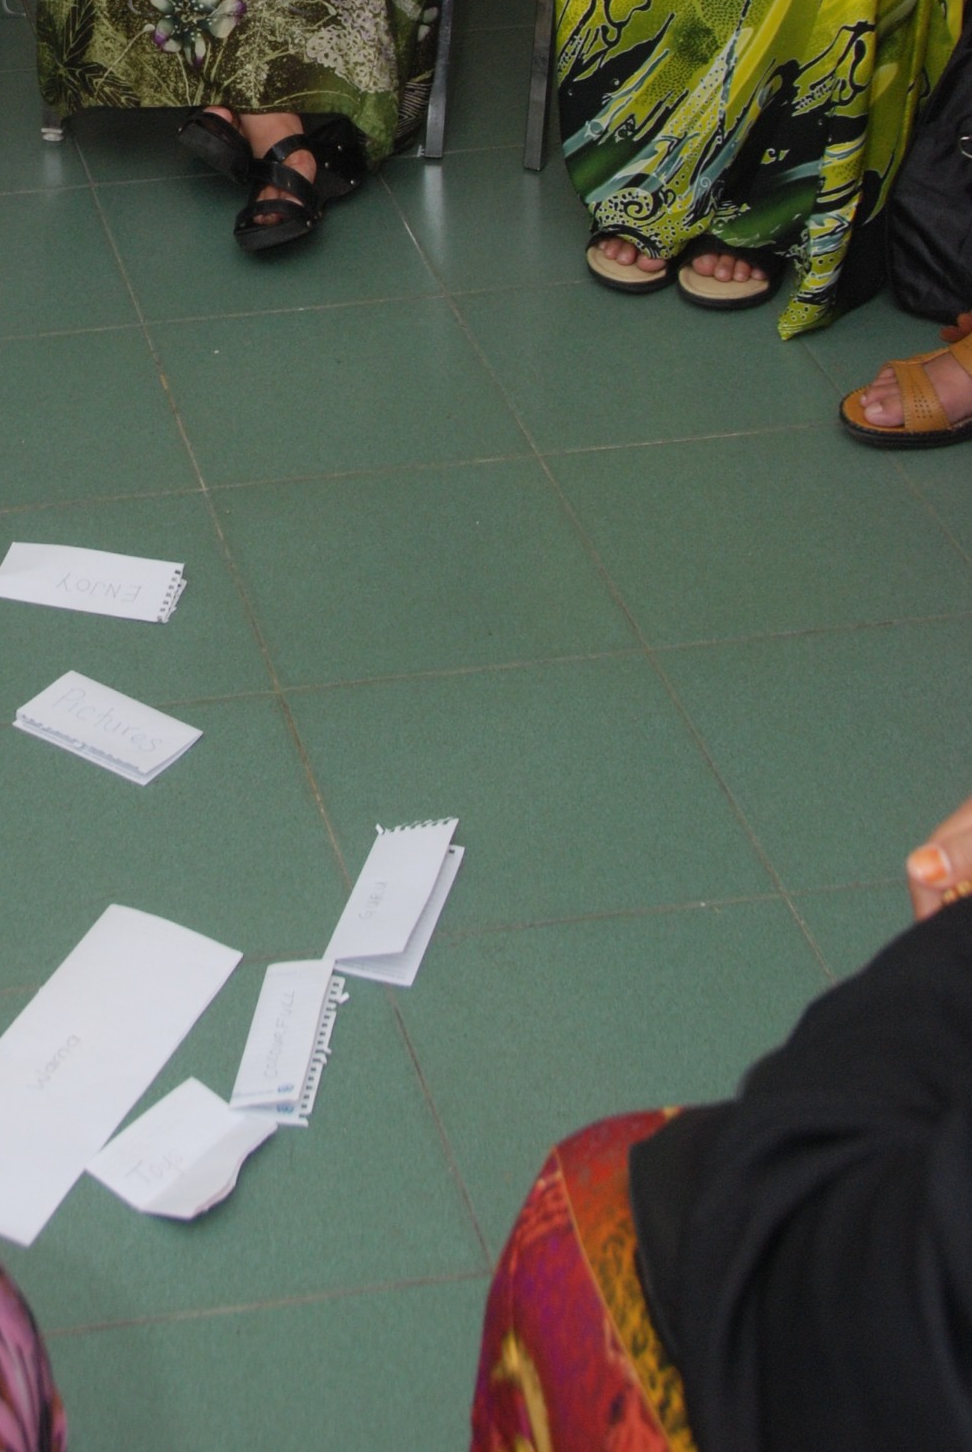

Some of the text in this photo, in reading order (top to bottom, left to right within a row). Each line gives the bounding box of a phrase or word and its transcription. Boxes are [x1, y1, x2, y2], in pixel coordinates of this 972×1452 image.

[55, 570, 143, 604] ENJOY
[51, 686, 165, 755] Pictures
[26, 1034, 81, 1093] Warna
